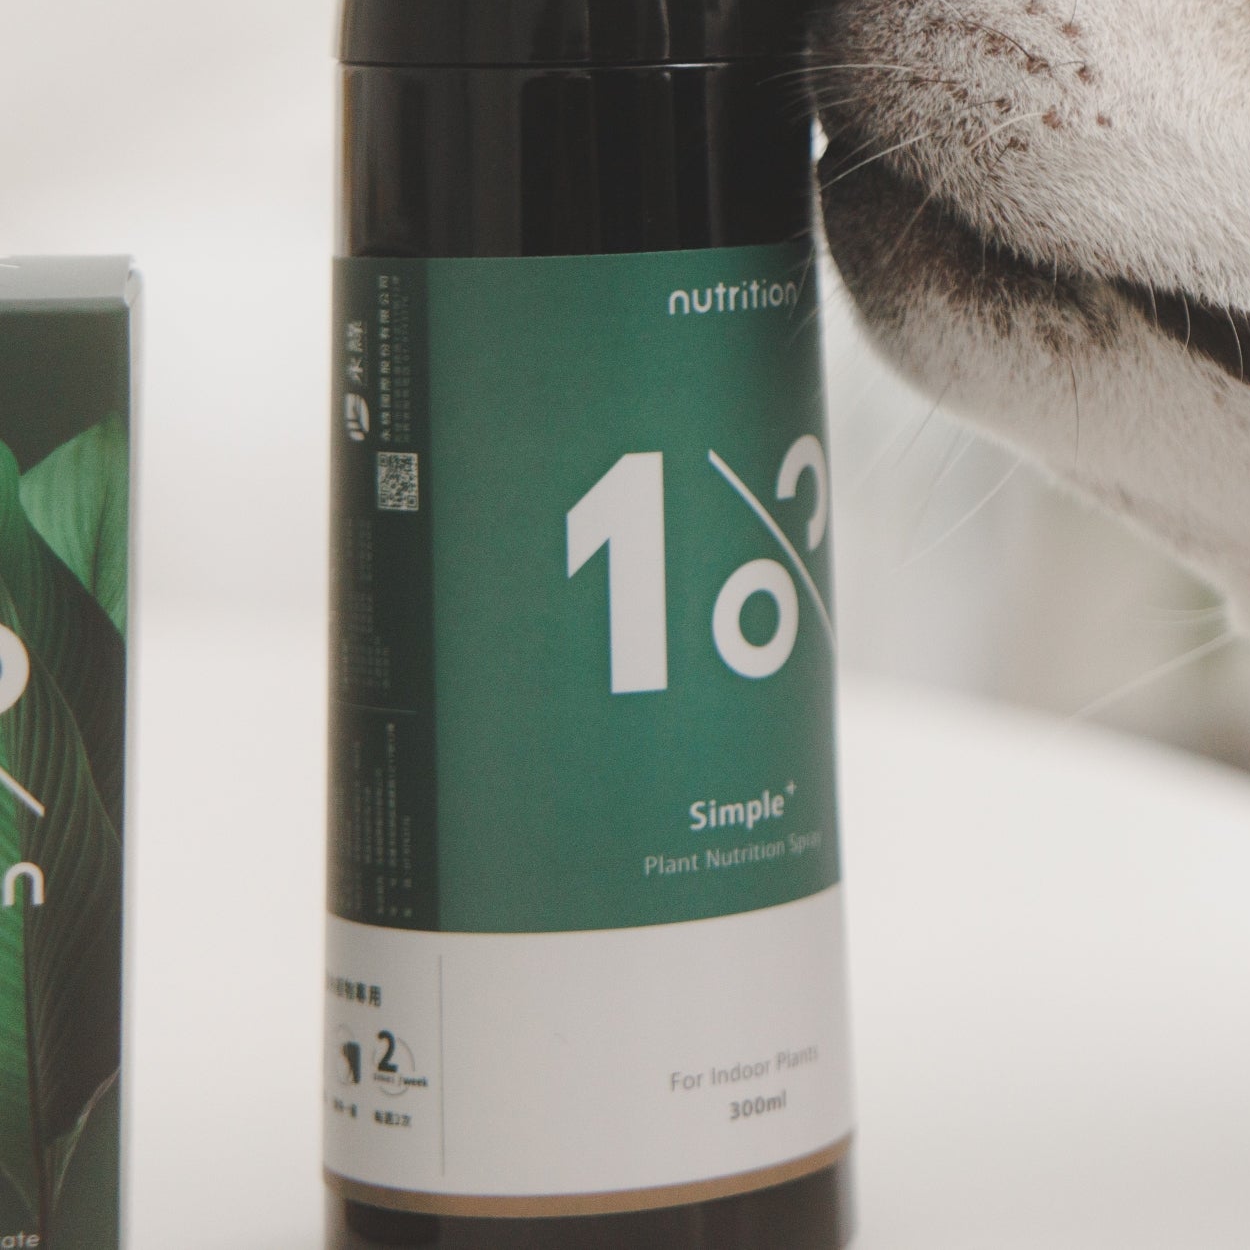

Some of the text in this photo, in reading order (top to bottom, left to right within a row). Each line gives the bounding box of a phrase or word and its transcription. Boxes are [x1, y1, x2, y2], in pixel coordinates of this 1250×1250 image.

[668, 279, 798, 316] nutrition
[643, 854, 699, 876] Plant
[706, 838, 786, 870] Nutrition
[377, 1029, 399, 1074] 2
[669, 1070, 704, 1092] For
[710, 1057, 772, 1086] Indoor
[729, 1089, 788, 1121] 300ml
